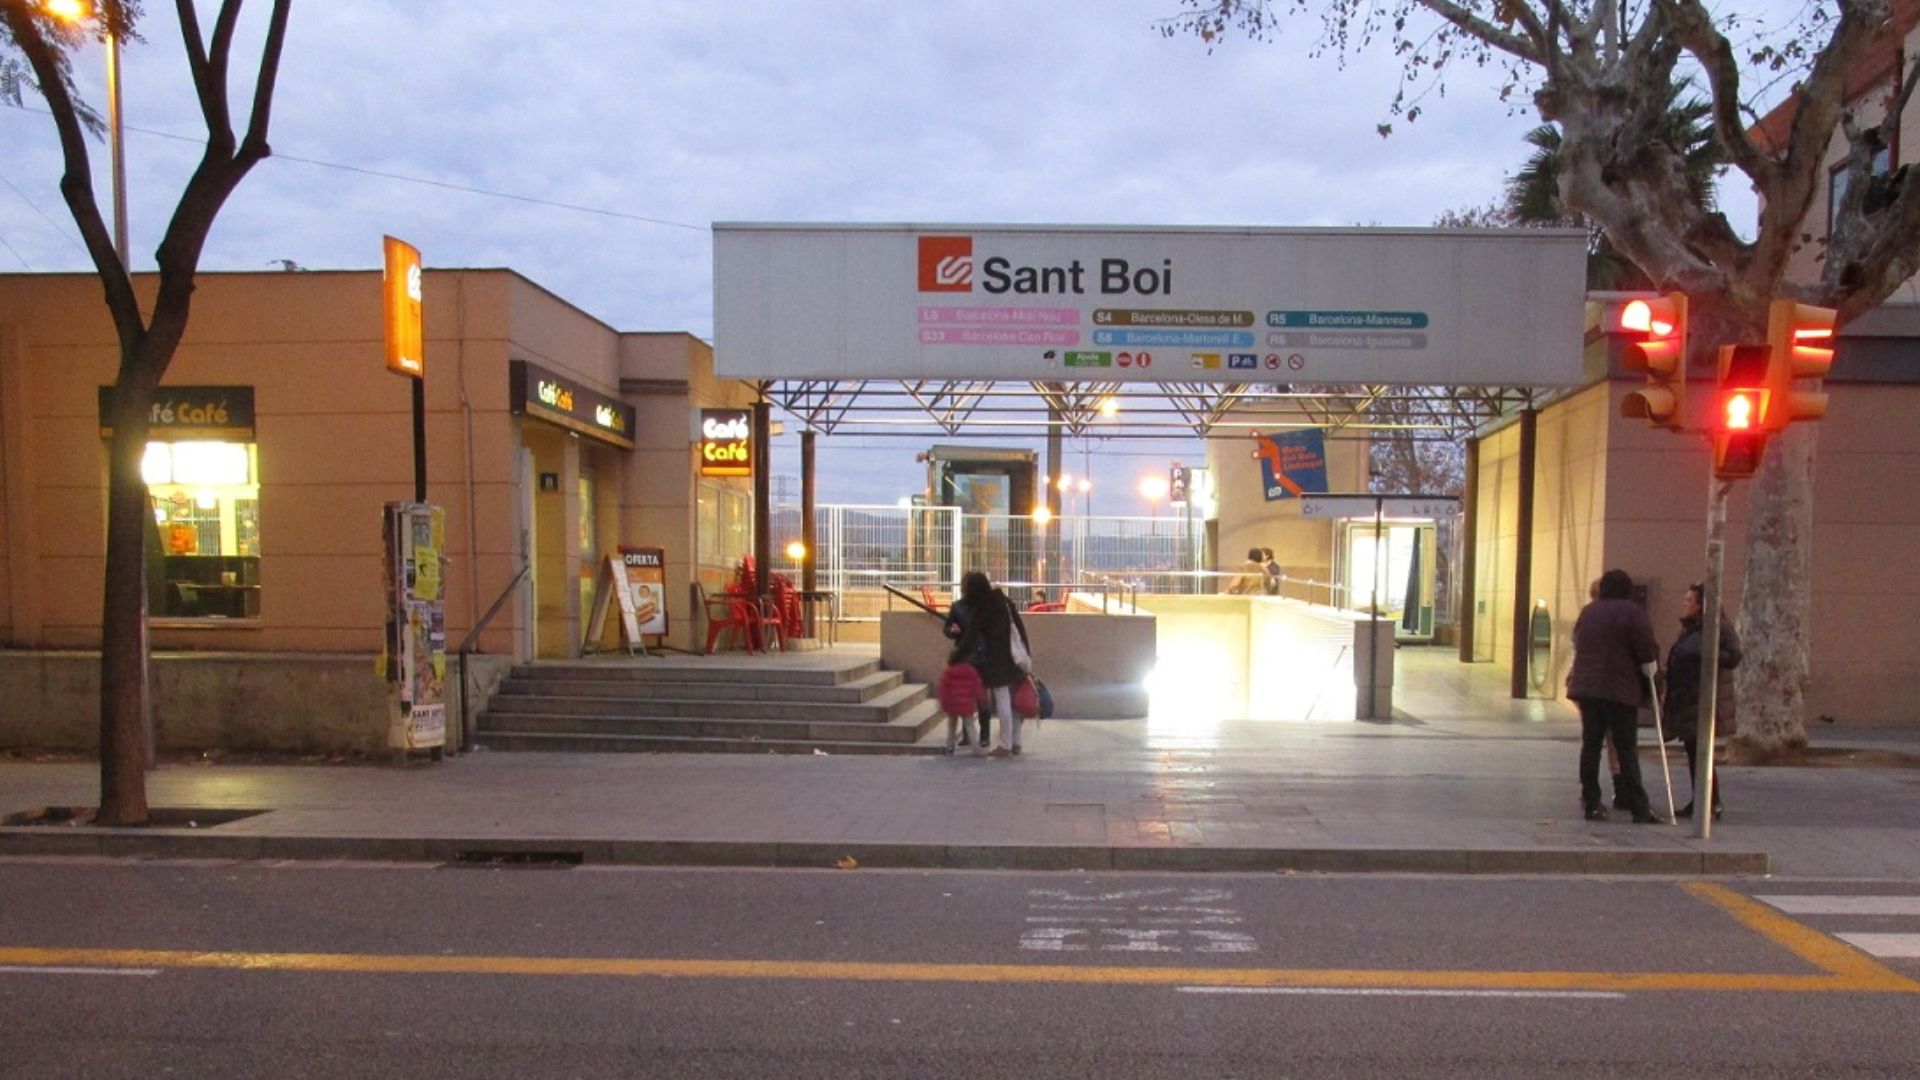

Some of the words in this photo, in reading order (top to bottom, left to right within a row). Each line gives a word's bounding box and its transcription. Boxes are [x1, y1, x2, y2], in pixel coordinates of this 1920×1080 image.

[982, 257, 1084, 294] Sant
[1101, 259, 1171, 294] Boi
[1097, 312, 1112, 322] S4
[1131, 312, 1215, 324] Barcelona-Olesa
[1217, 315, 1231, 324] de
[1270, 314, 1286, 324] R5
[1309, 314, 1412, 326] Barcelona-Manresa
[1270, 336, 1286, 345] R6
[1231, 356, 1240, 367] P
[178, 402, 229, 423] Café
[703, 414, 749, 440] Café
[703, 441, 748, 461] Café
[626, 555, 659, 566] OFERTA
